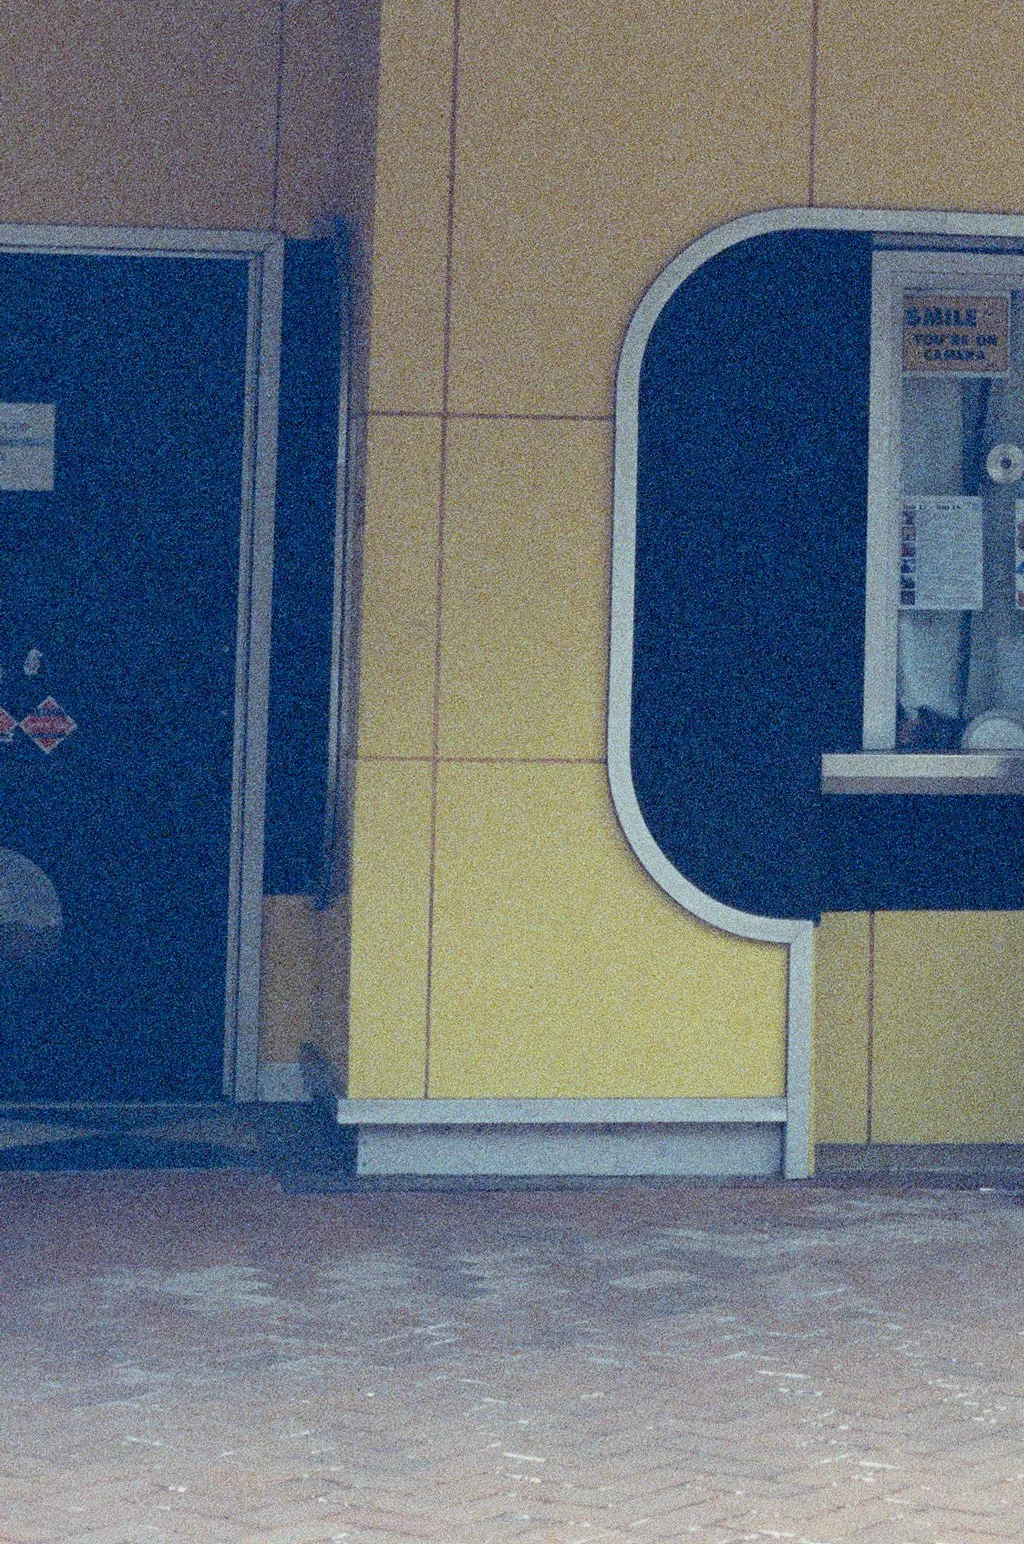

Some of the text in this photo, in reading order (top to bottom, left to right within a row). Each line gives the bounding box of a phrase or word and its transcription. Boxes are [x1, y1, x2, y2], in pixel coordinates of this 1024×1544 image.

[904, 307, 978, 328] SMILE
[975, 334, 999, 348] ON
[923, 348, 987, 361] CAMERA
